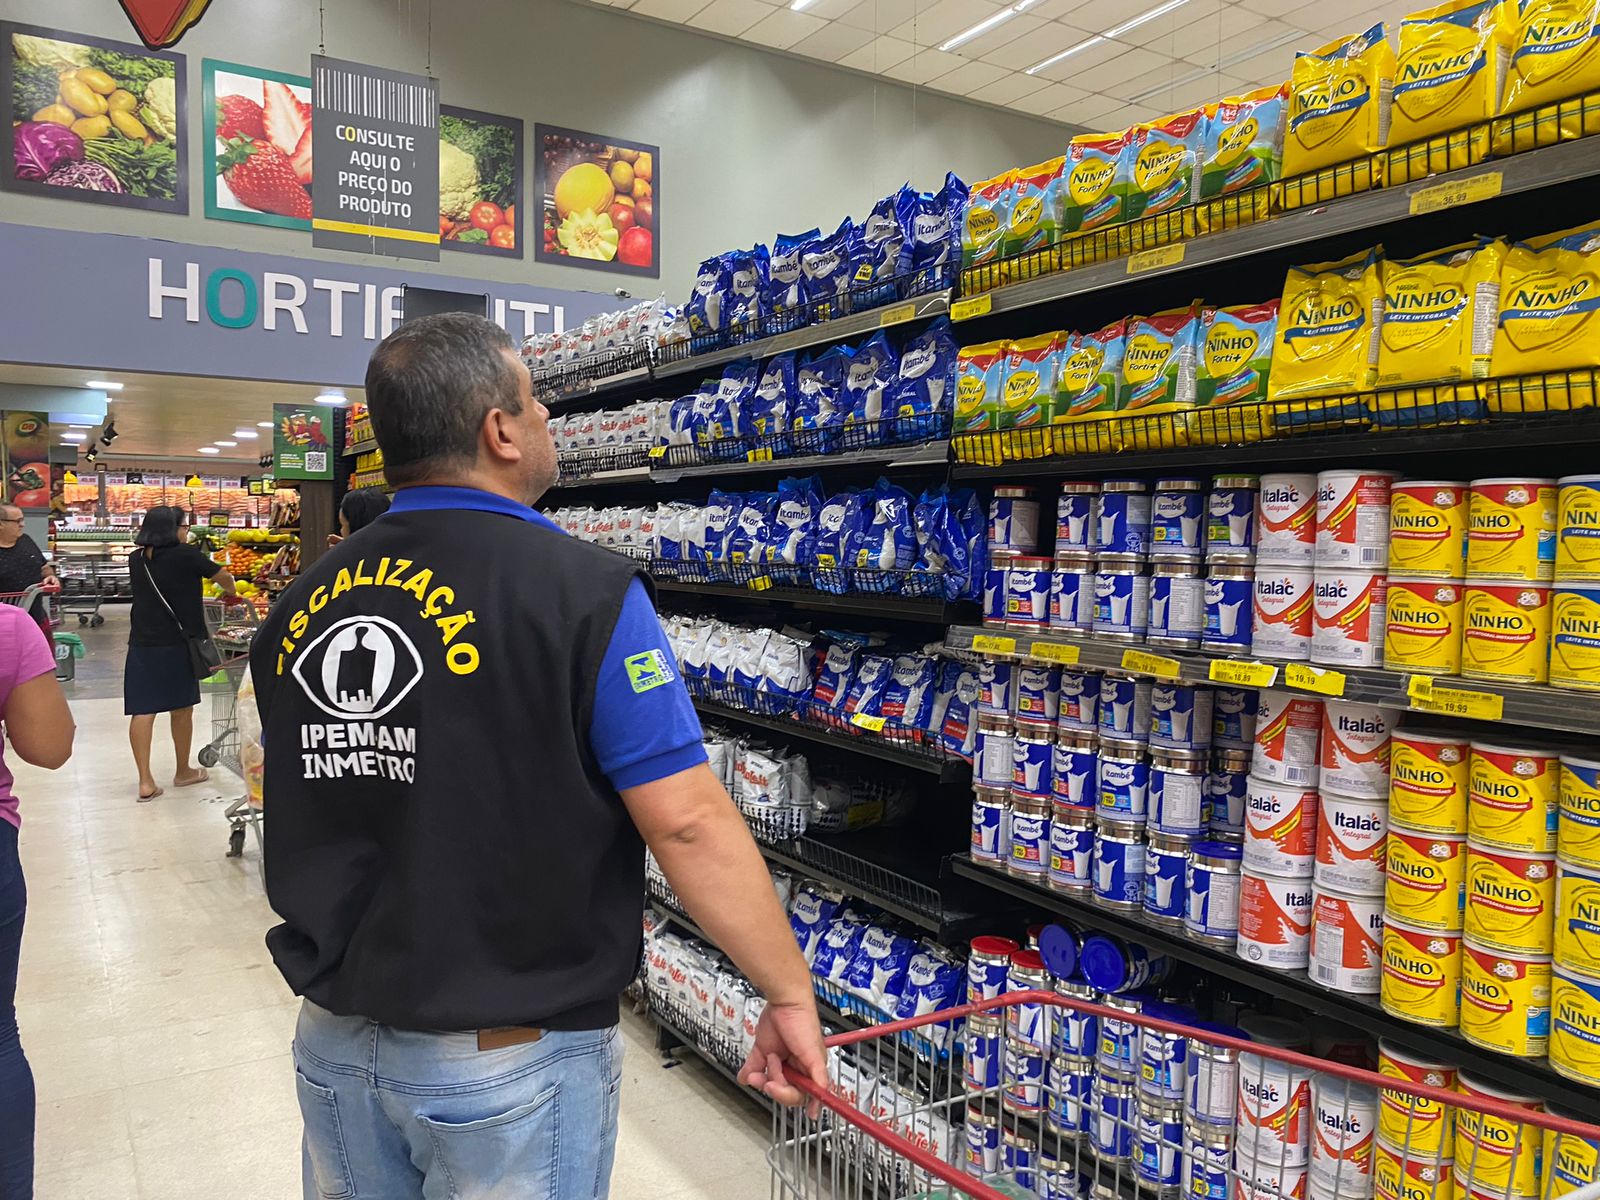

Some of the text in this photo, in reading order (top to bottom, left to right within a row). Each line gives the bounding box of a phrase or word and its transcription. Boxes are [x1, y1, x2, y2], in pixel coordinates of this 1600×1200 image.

[1402, 50, 1474, 81] NINHO
[1408, 80, 1430, 89] LEITE
[335, 124, 415, 152] CONSULTE
[350, 150, 401, 172] AQUI O
[338, 171, 413, 196] PREÇO DO
[339, 194, 412, 218] PRODUTO
[968, 214, 996, 229] NINHO
[1386, 288, 1457, 309] NINHO
[1514, 279, 1589, 308] NINHO
[1297, 299, 1356, 327] NINHO
[1389, 310, 1448, 321] LEITE INTEGRAL
[1207, 337, 1254, 354] NINHO
[1128, 348, 1169, 361] NINHO
[1212, 353, 1242, 364] Forti+
[1129, 362, 1157, 371] Forti+
[1262, 487, 1299, 503] Italac
[1158, 502, 1182, 511] itambé
[1392, 514, 1439, 528] NINHO
[1011, 577, 1032, 587] itambé
[1258, 580, 1294, 595] Italac
[1390, 609, 1440, 624] NINHO
[1469, 613, 1523, 630] NINHO
[1338, 715, 1385, 734] Italac
[1345, 732, 1376, 743] Integral
[301, 751, 415, 784] INMETRO
[1105, 769, 1131, 780] itambé
[1395, 764, 1444, 784] NINHO
[1471, 777, 1519, 798] NINHO
[1017, 825, 1040, 834] itambé
[1335, 811, 1381, 832] Italac
[1054, 835, 1075, 845] itambé
[1342, 829, 1372, 840] Integral
[1388, 858, 1435, 879] NINHO
[1474, 878, 1532, 902] NINHO
[911, 961, 934, 978] itambé
[1385, 950, 1434, 976] NINHO
[1318, 1106, 1361, 1134] Italac
[1458, 1109, 1508, 1142] NINHO
